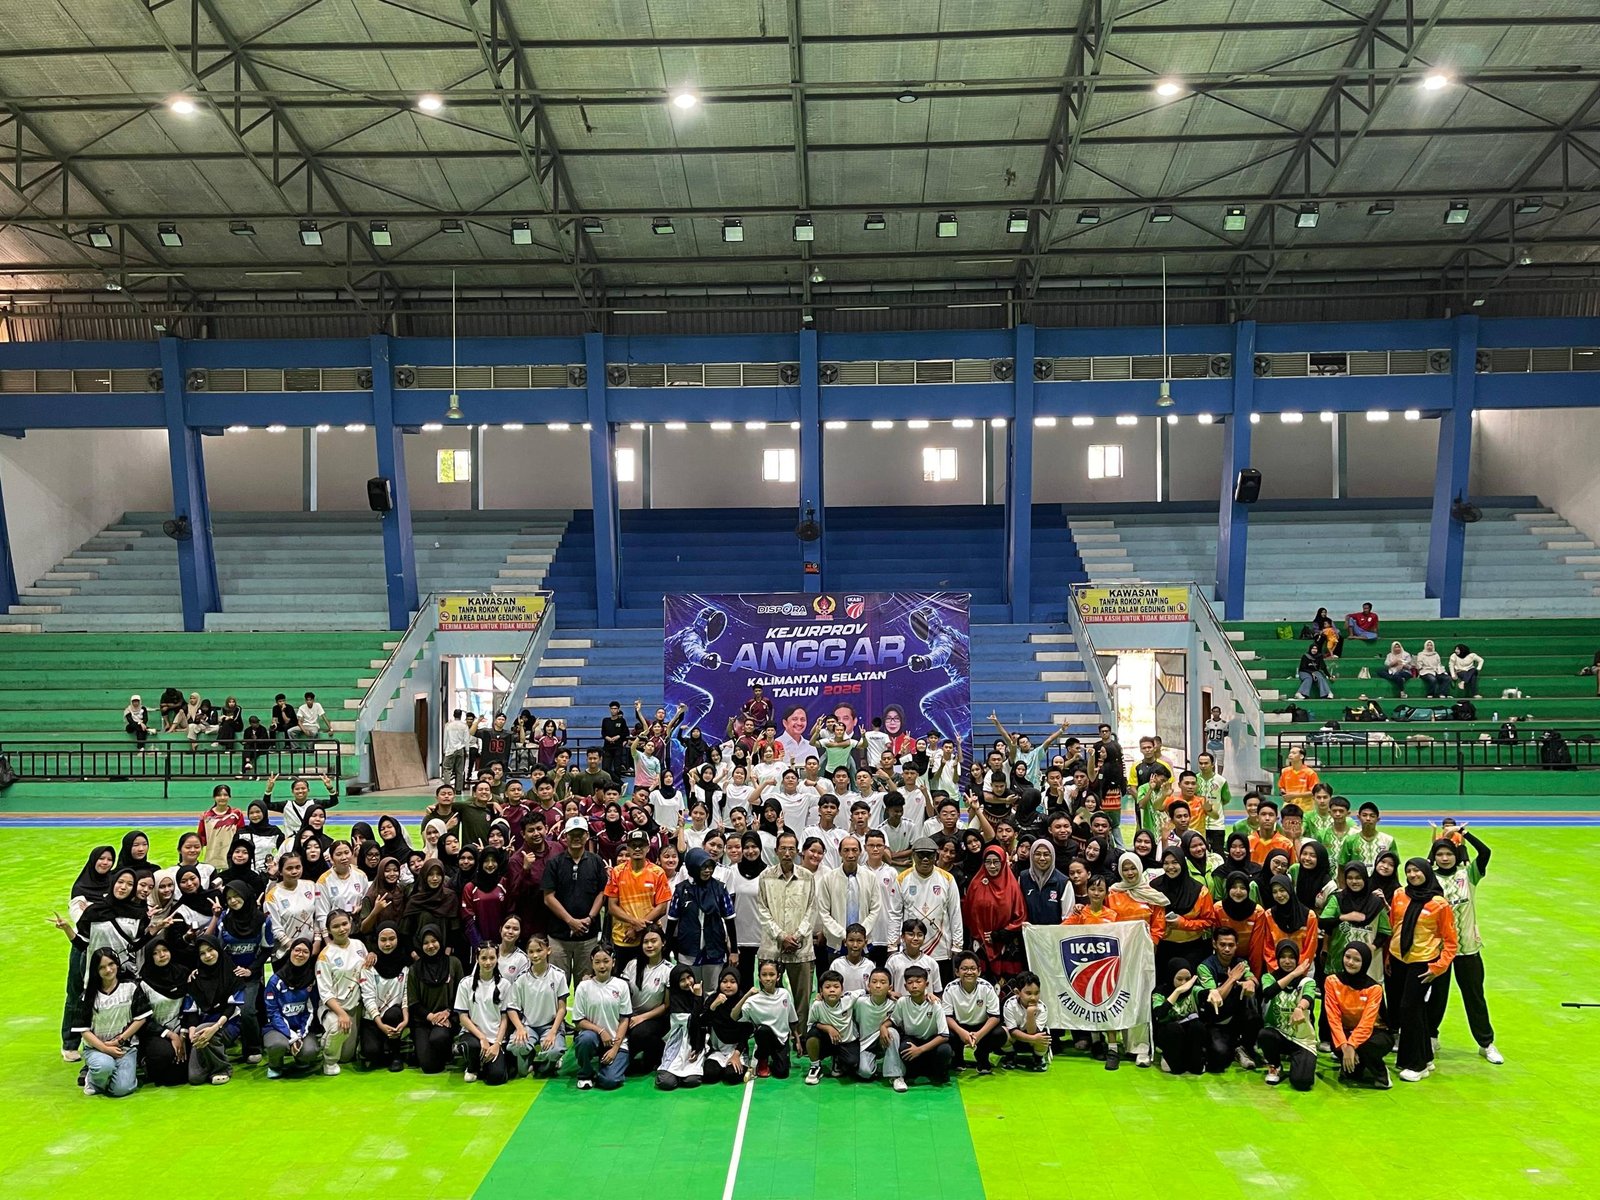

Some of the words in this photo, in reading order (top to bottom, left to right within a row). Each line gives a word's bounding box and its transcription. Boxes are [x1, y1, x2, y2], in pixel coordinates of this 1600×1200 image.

[1110, 589, 1158, 597] KAWASAN
[468, 597, 516, 605] KAWASAN
[757, 603, 807, 616] DISPORA
[765, 623, 868, 639] KEJURPROV
[729, 635, 906, 672] ANGGAR
[747, 674, 827, 687] KALIMANTAN
[831, 671, 887, 683] SELATAN
[773, 686, 819, 697] TAHUN
[823, 684, 862, 695] 2026
[1209, 729, 1222, 740] 09
[1070, 942, 1111, 954] IKASI
[1058, 991, 1109, 1023] KABUPATEN
[1108, 990, 1131, 1018] TAPIN
